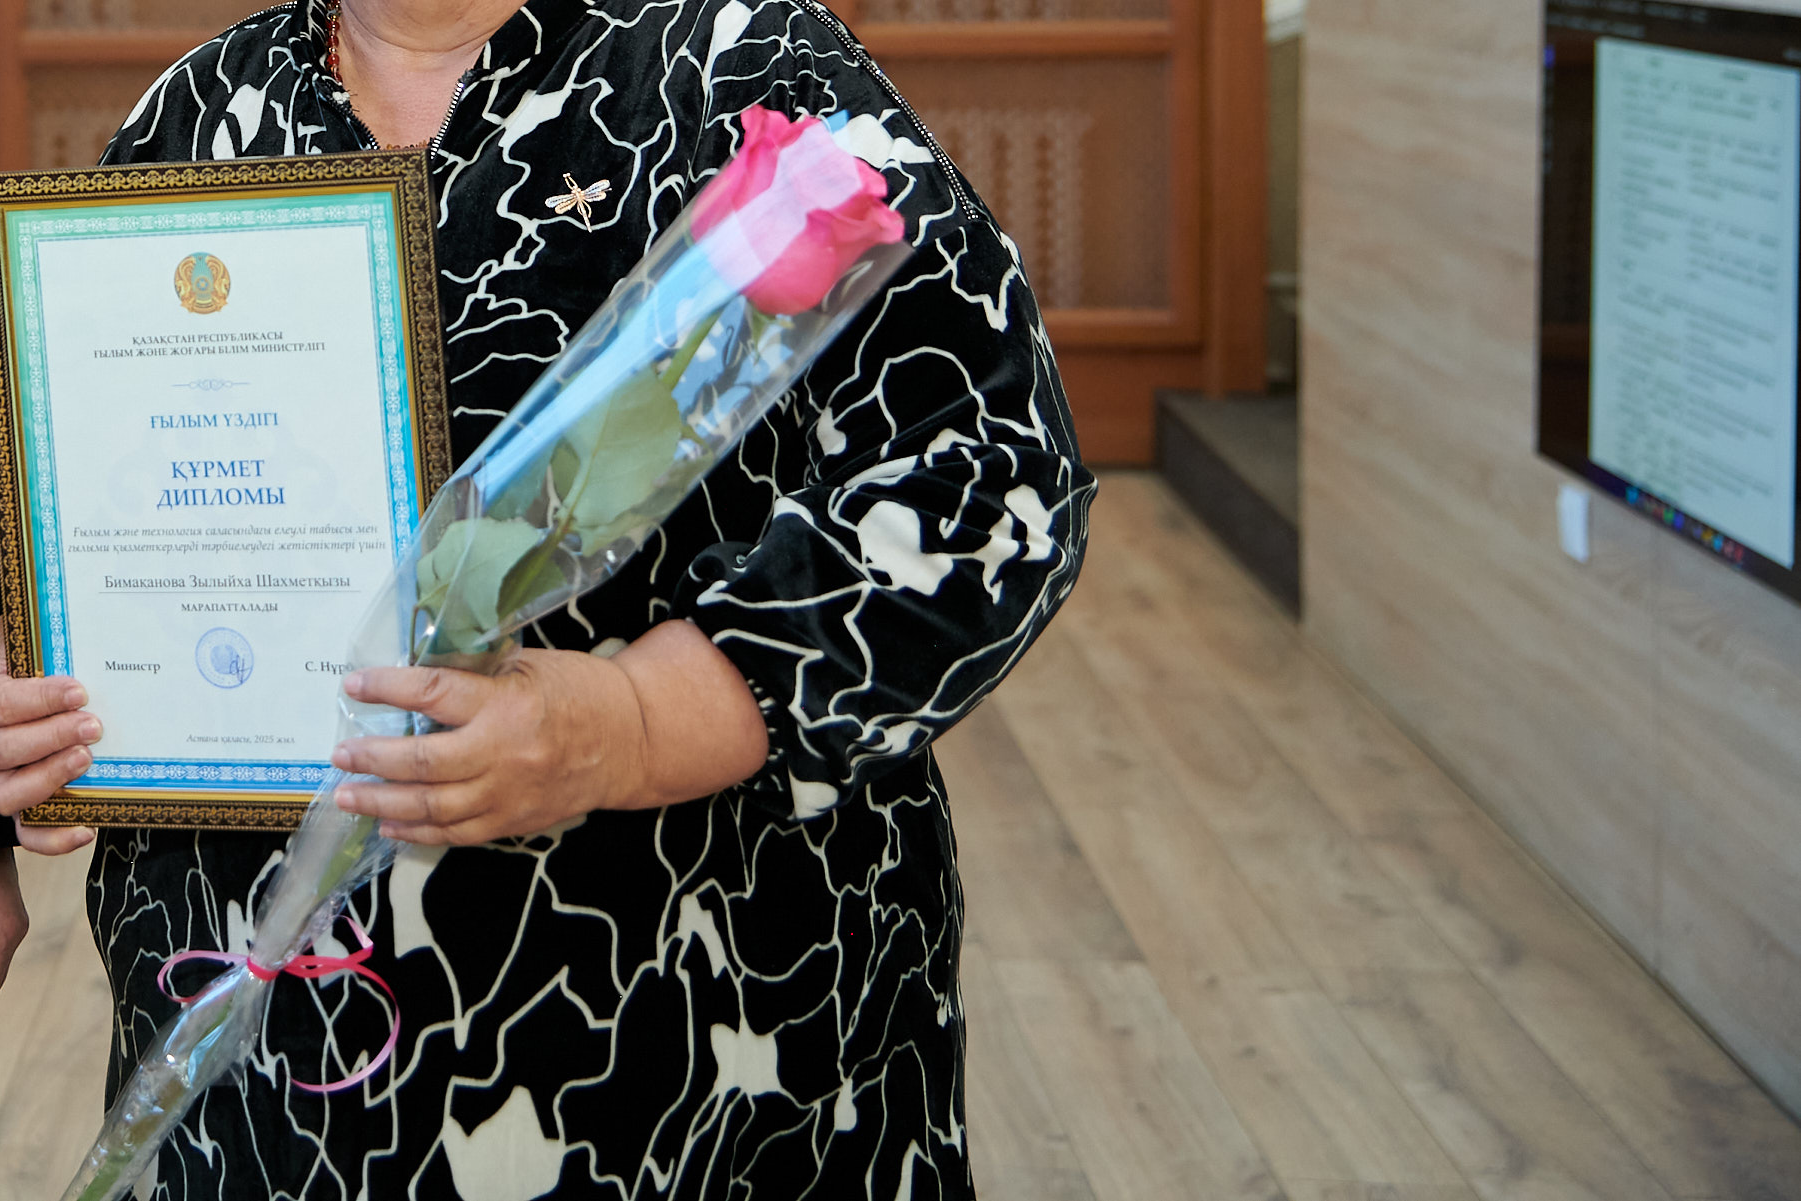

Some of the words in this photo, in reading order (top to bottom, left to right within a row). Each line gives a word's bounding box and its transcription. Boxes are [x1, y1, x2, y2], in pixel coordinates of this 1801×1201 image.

[132, 334, 196, 346] ҚАЗАҚСТАН
[197, 331, 284, 343] РЕСПУБЛИКАСЫ
[135, 347, 169, 358] ЖӘНЕ
[169, 345, 216, 356] ЖОҒАРЫ
[217, 344, 250, 355] БІЛІМ
[251, 342, 327, 354] МИНИСТРЛІГІ
[150, 414, 219, 430] ҒЫЛЫМ
[222, 412, 280, 430] ҮЗДІГІ
[171, 459, 266, 483] ҚҰРМЕТ
[156, 486, 287, 511] ДИПЛОМЫ
[112, 528, 140, 537] және
[141, 527, 203, 538] технология
[273, 523, 307, 538] елеулі
[309, 523, 354, 535] табысы
[355, 524, 379, 534] мен
[358, 538, 386, 553] үшін
[188, 574, 253, 588] Зылыйха
[180, 602, 279, 613] МАРАПАТТАЛАДЫ
[104, 660, 162, 675] Министр
[304, 660, 318, 673] С.
[185, 733, 219, 744] Астана
[254, 734, 275, 744] 2025
